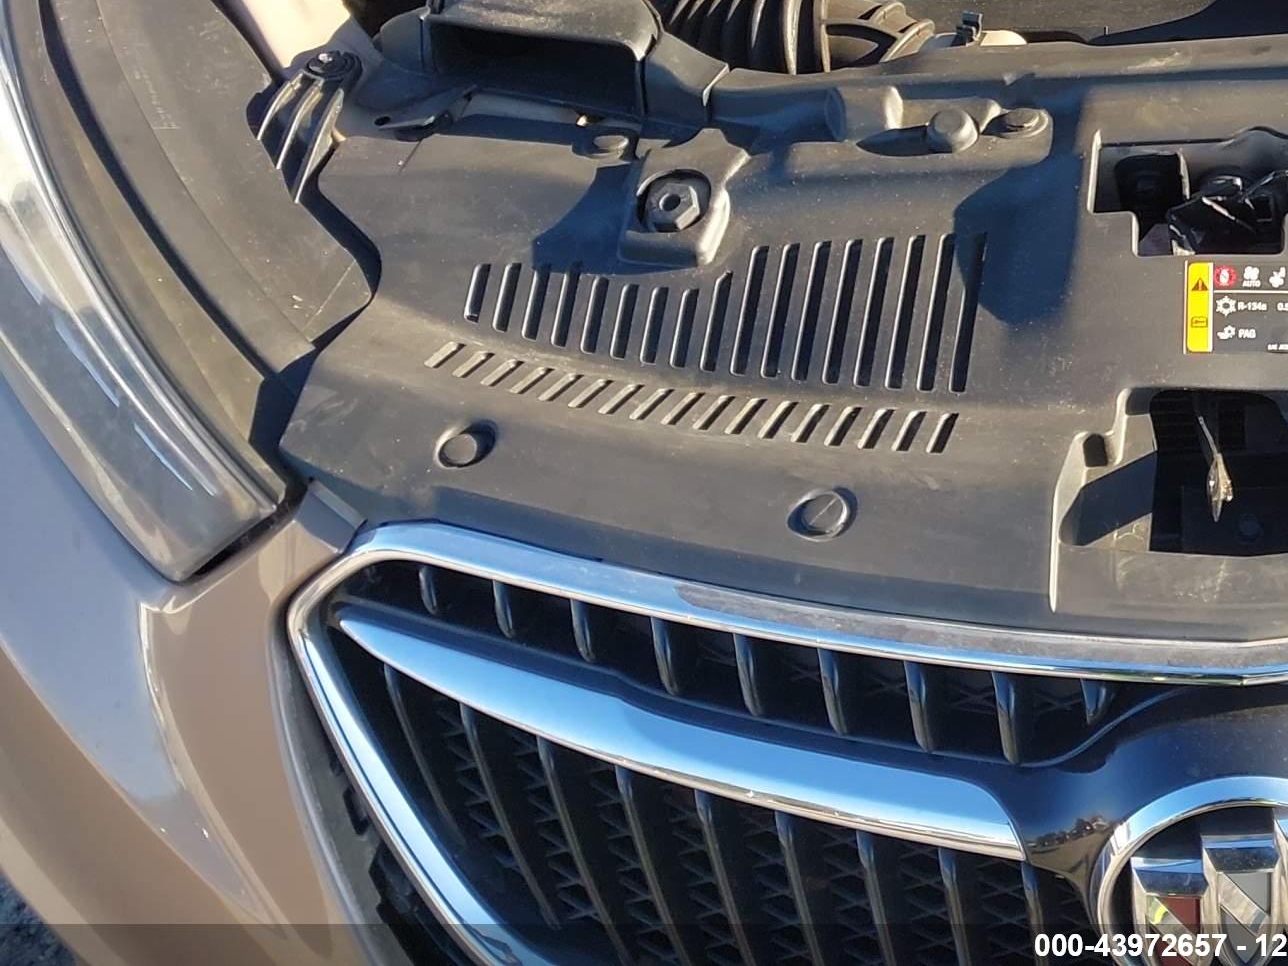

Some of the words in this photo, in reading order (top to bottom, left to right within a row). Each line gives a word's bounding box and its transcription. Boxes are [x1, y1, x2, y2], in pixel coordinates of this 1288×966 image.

[1242, 280, 1262, 288] AUTO
[1237, 301, 1268, 311] R-134a
[1238, 328, 1257, 339] PAG
